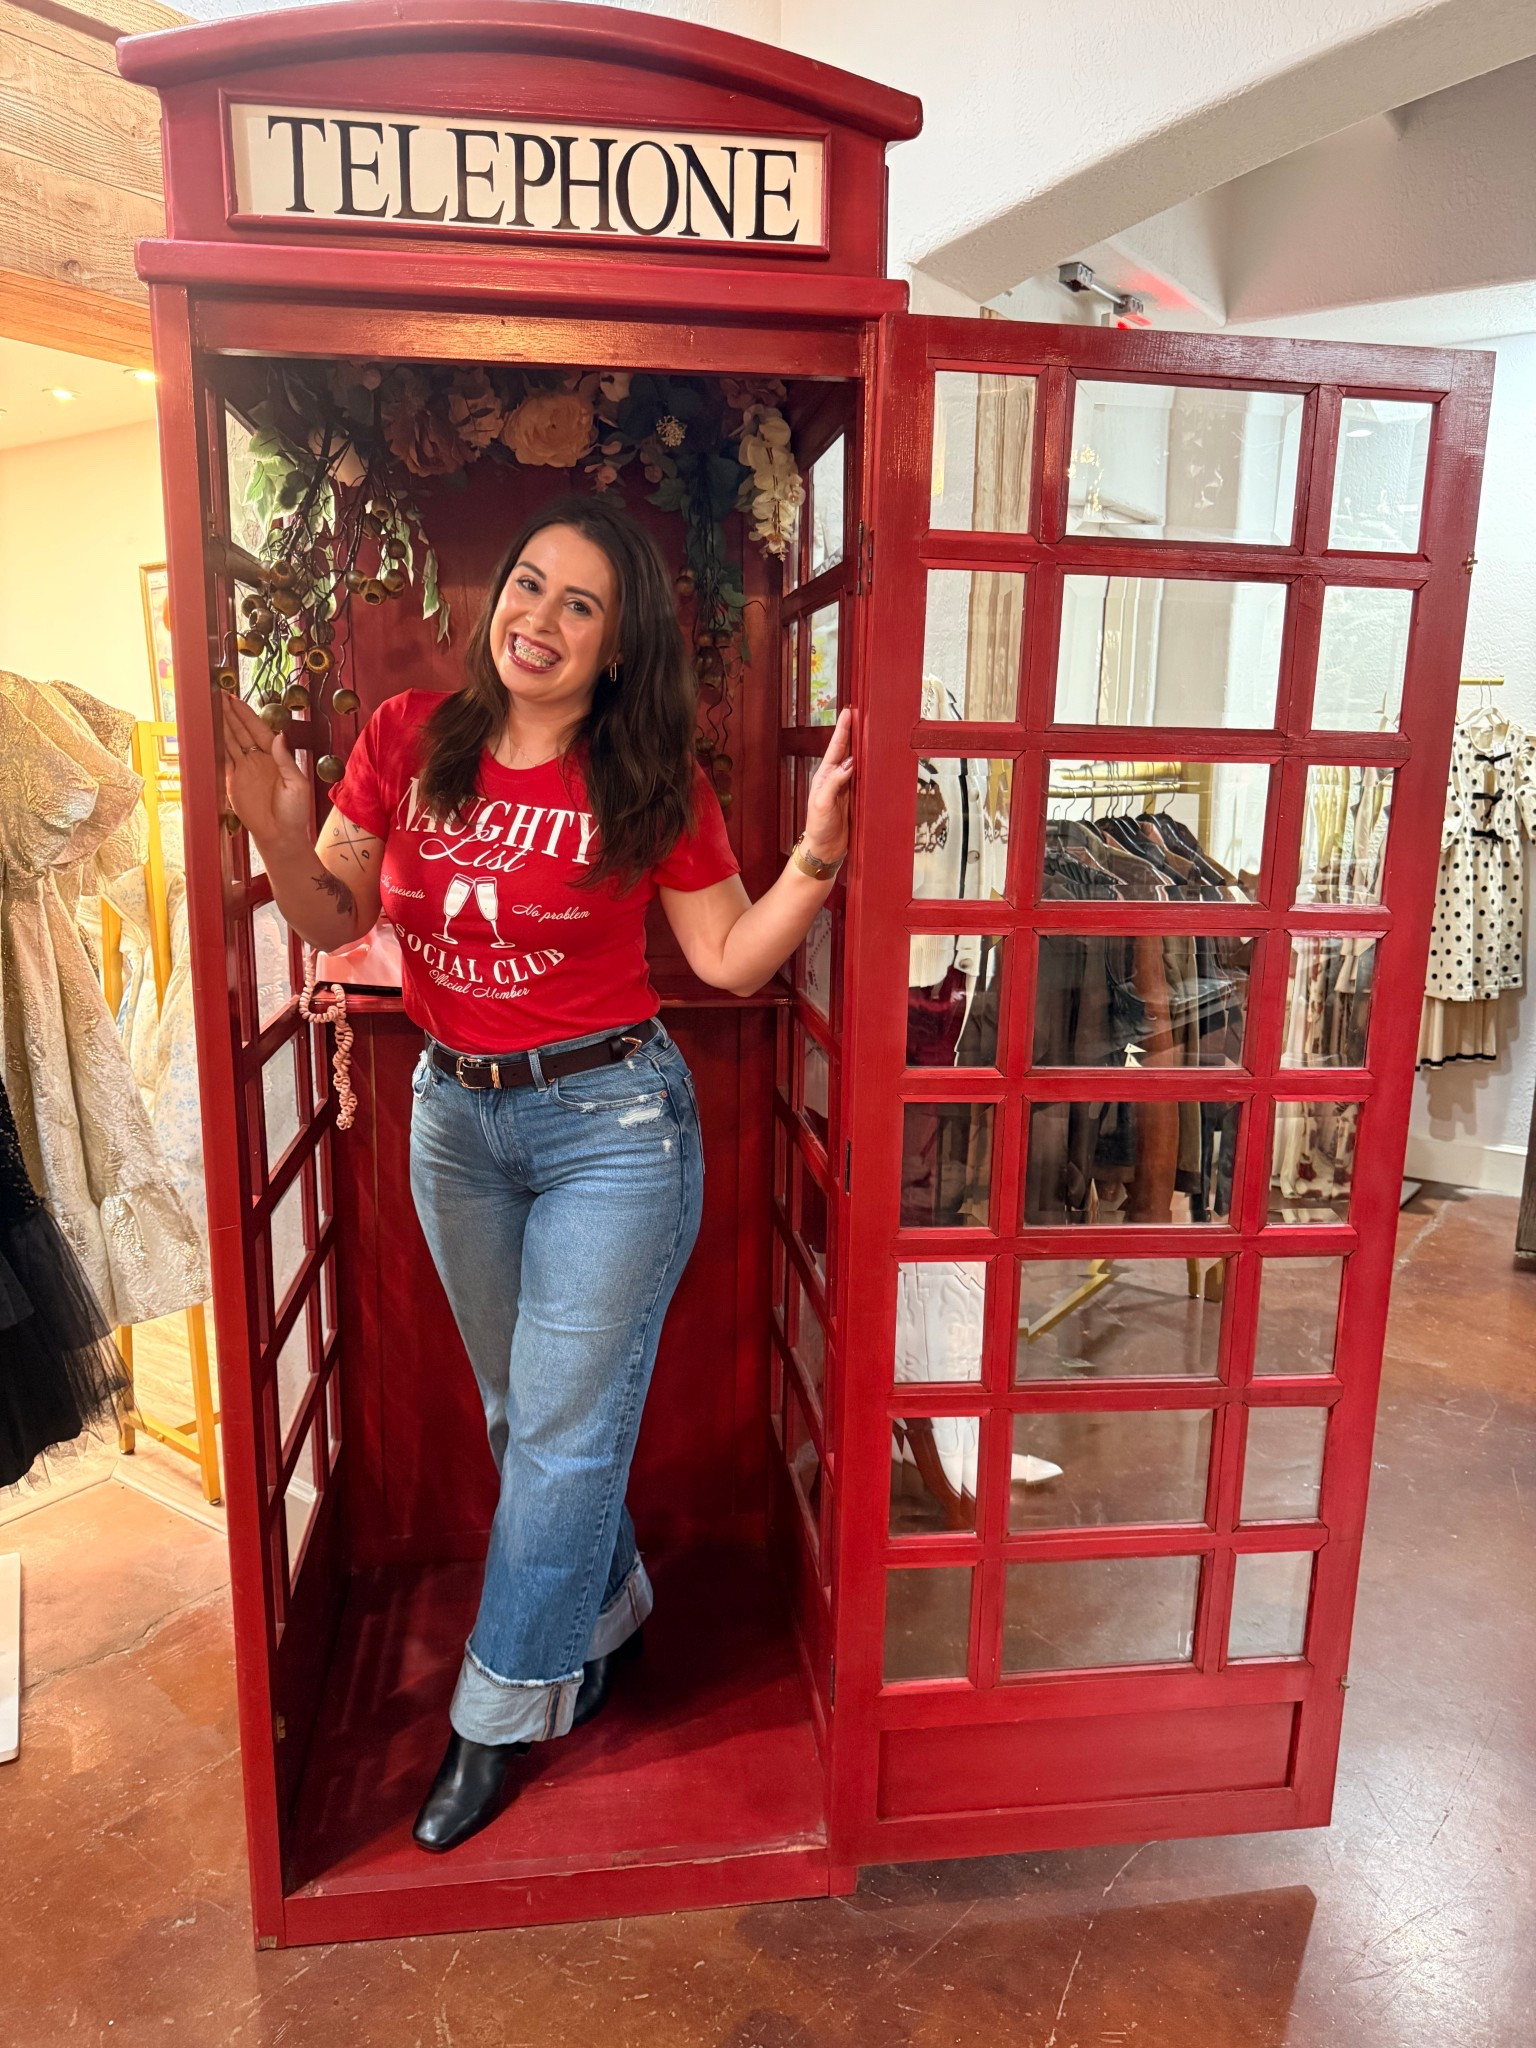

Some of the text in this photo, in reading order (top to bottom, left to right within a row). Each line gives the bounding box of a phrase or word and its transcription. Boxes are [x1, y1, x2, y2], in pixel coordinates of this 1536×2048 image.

[267, 114, 801, 242] TELEPHONE
[419, 829, 532, 873] List
[388, 885, 426, 899] presents
[512, 903, 591, 923] No problem
[395, 923, 565, 985] SOCIAL CLUB
[429, 969, 531, 1000] Official Member
